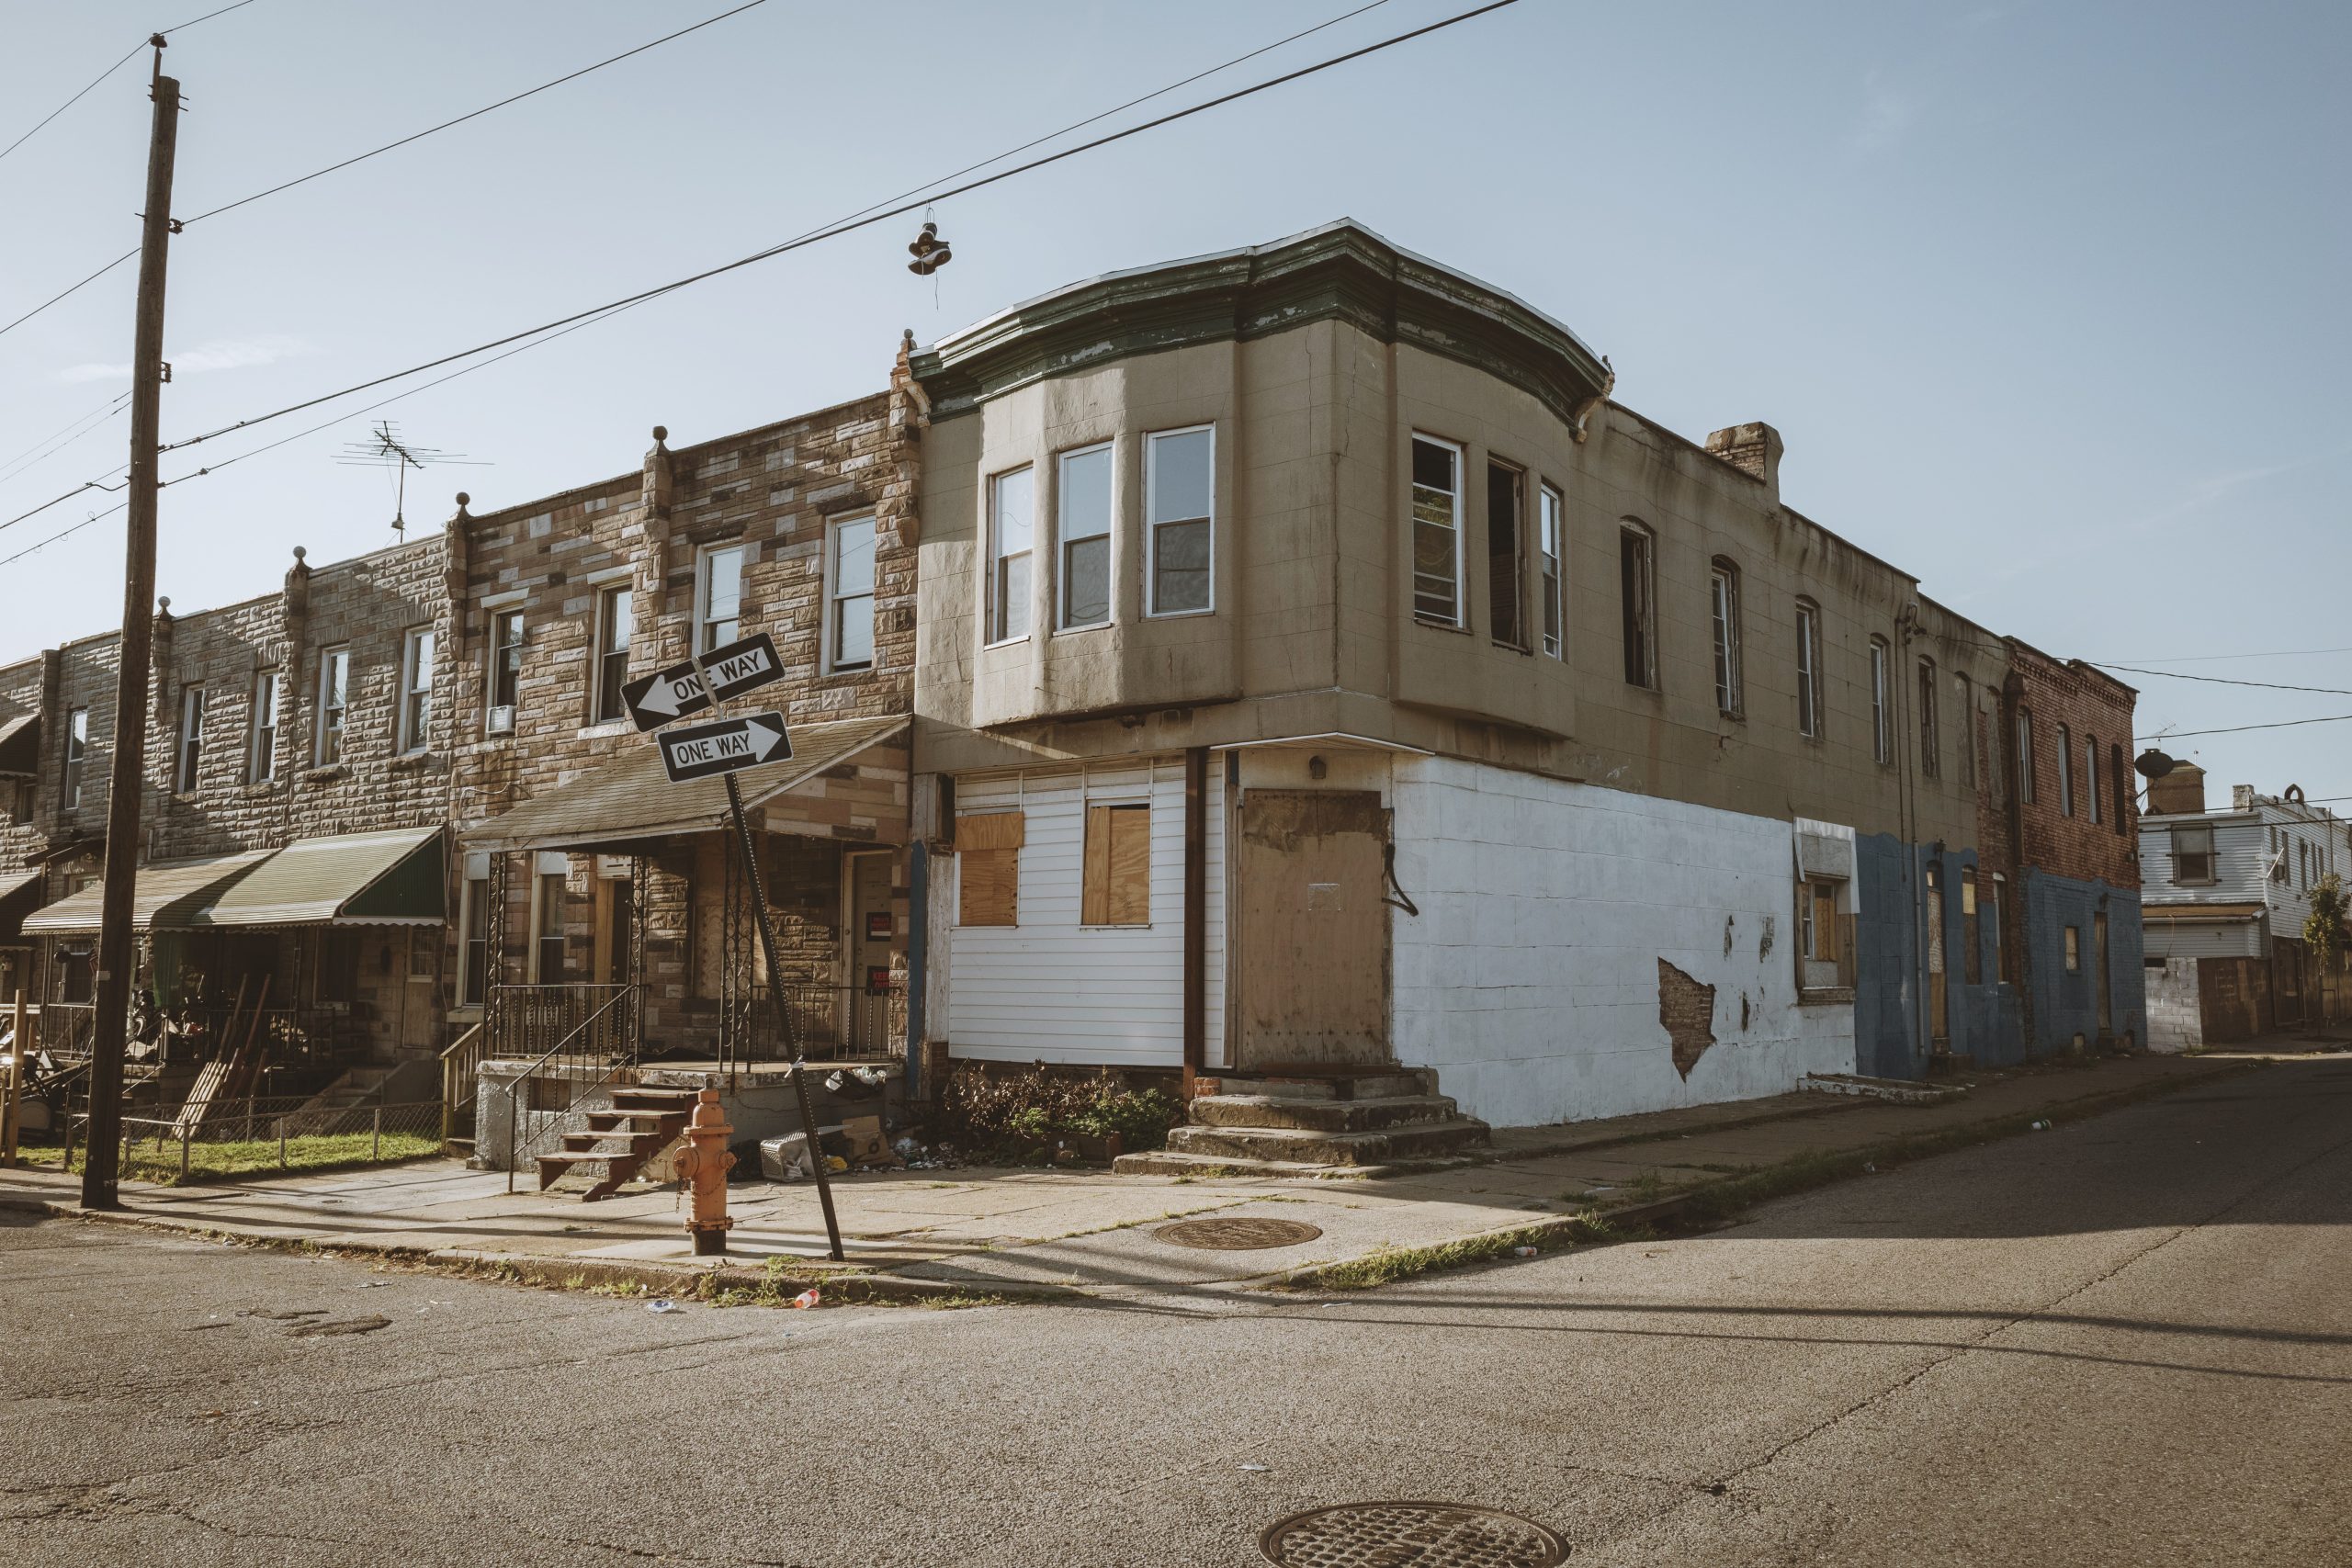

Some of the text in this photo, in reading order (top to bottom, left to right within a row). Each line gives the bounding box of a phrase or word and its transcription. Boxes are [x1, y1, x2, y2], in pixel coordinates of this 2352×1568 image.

[673, 651, 761, 700] ONE WAY
[676, 733, 750, 764] ONE WAY
